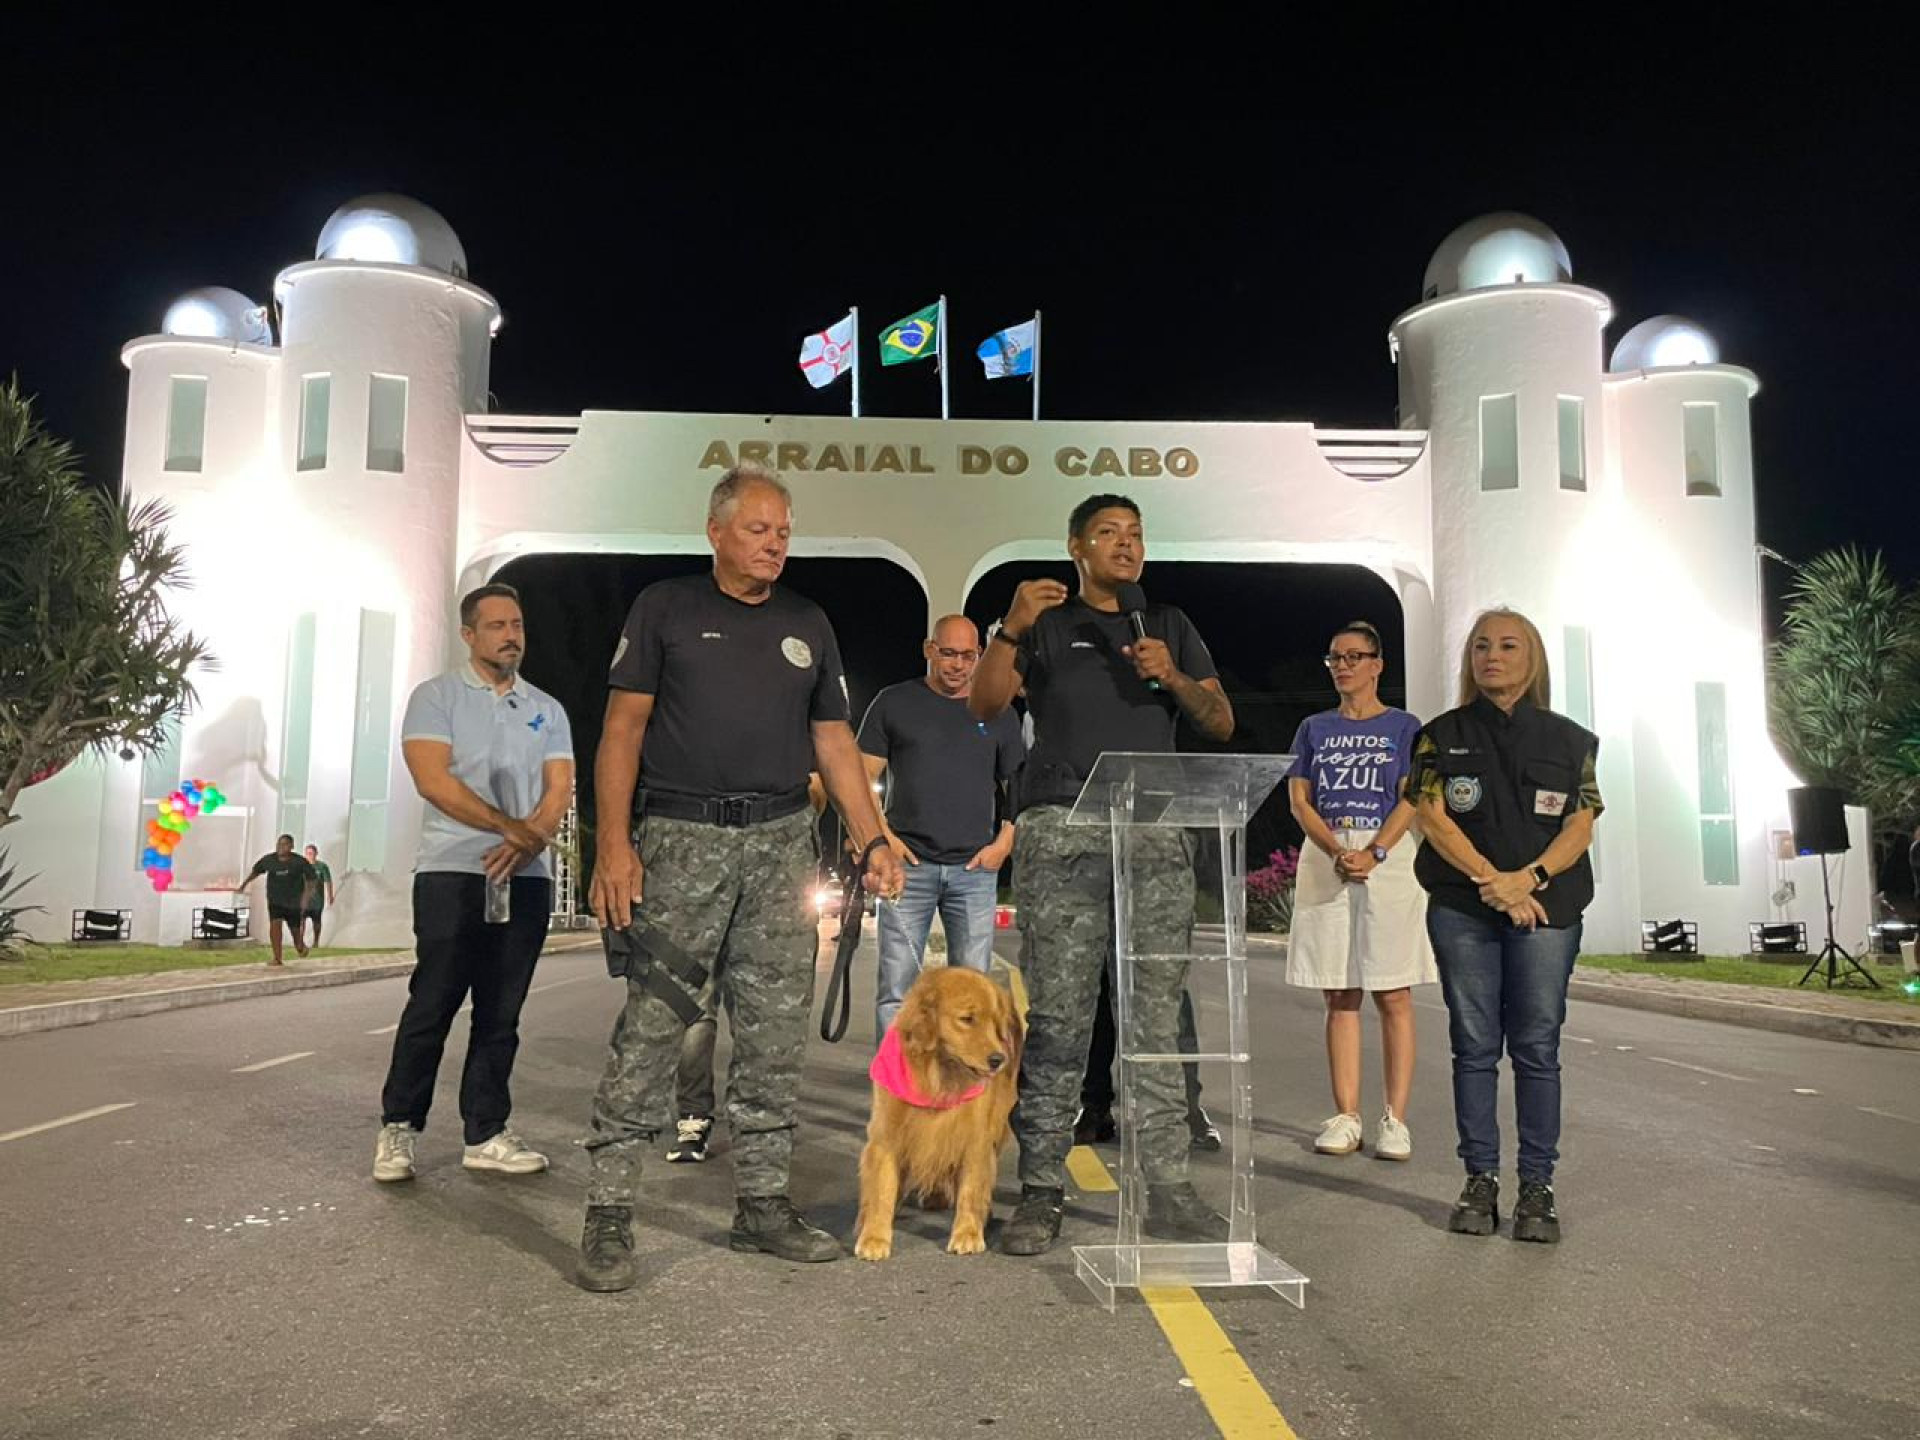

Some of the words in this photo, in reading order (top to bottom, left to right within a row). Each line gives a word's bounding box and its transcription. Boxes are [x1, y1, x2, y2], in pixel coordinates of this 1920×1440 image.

[698, 439, 935, 475] ARRAIAL
[960, 443, 1029, 477] DO
[1055, 446, 1199, 479] CABO
[1320, 735, 1390, 750] JUNTOS
[1318, 767, 1385, 792] AZUL
